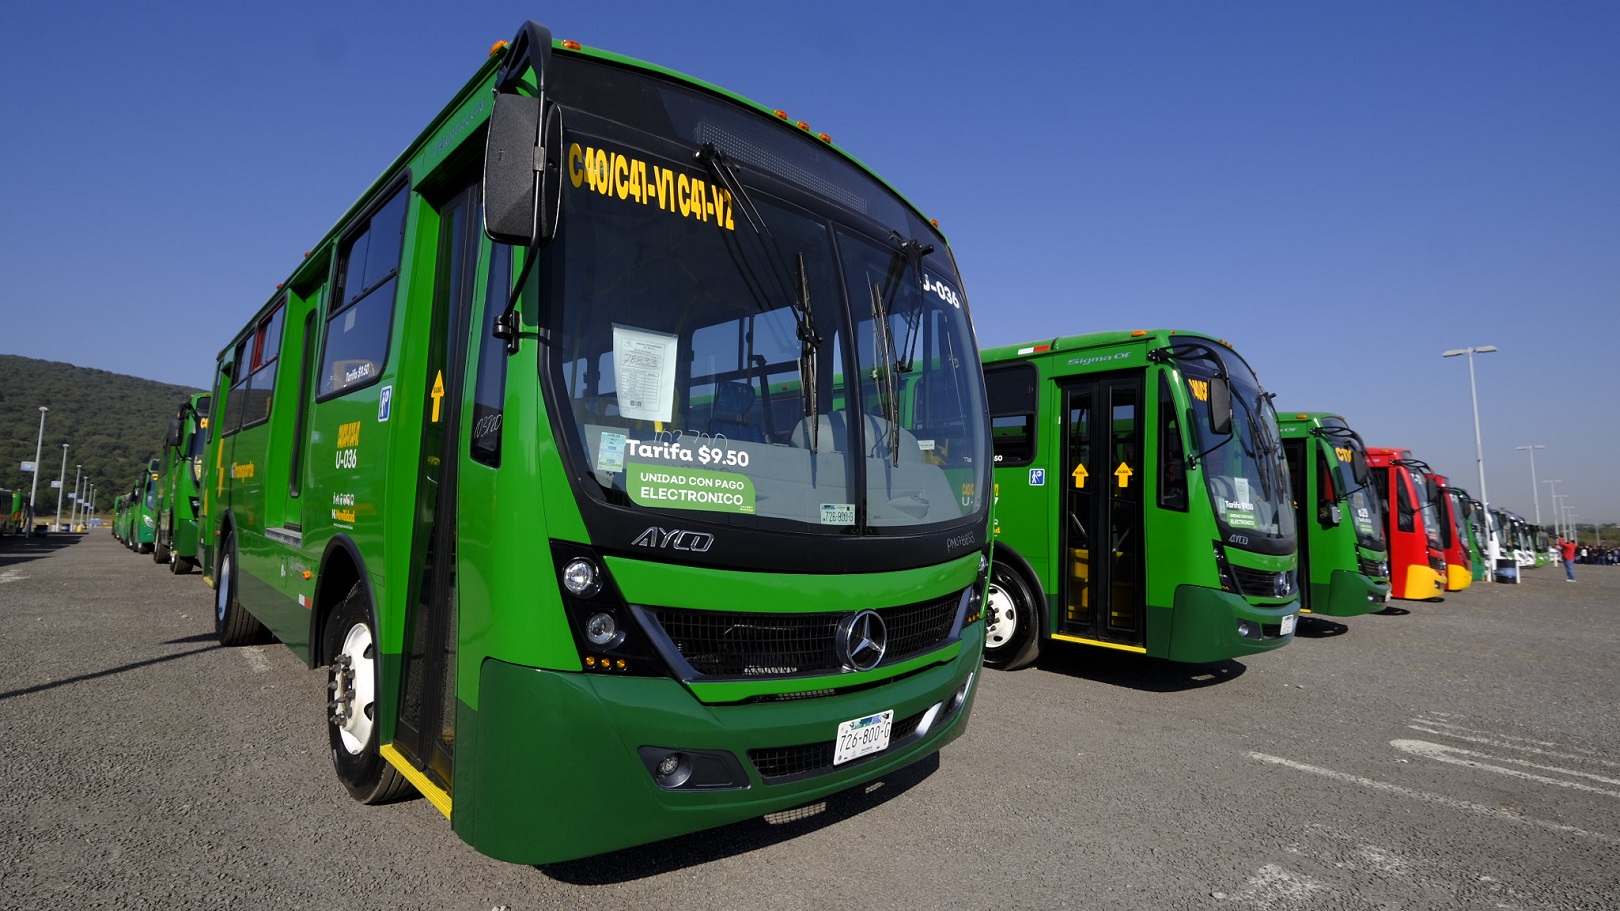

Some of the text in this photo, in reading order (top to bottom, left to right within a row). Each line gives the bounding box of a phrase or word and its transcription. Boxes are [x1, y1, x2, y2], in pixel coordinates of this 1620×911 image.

[569, 142, 735, 231] C40/C41-V1 C41-V2
[1067, 351, 1132, 366] Sigma OF
[335, 448, 357, 469] U-036
[626, 438, 693, 463] Tarifa
[697, 444, 750, 468] $9.50
[640, 472, 745, 491] UNIDAD CON PAGO
[640, 486, 744, 506] ELECTRONICO
[631, 526, 715, 553] AYCO
[839, 721, 891, 753] 726-800-G
